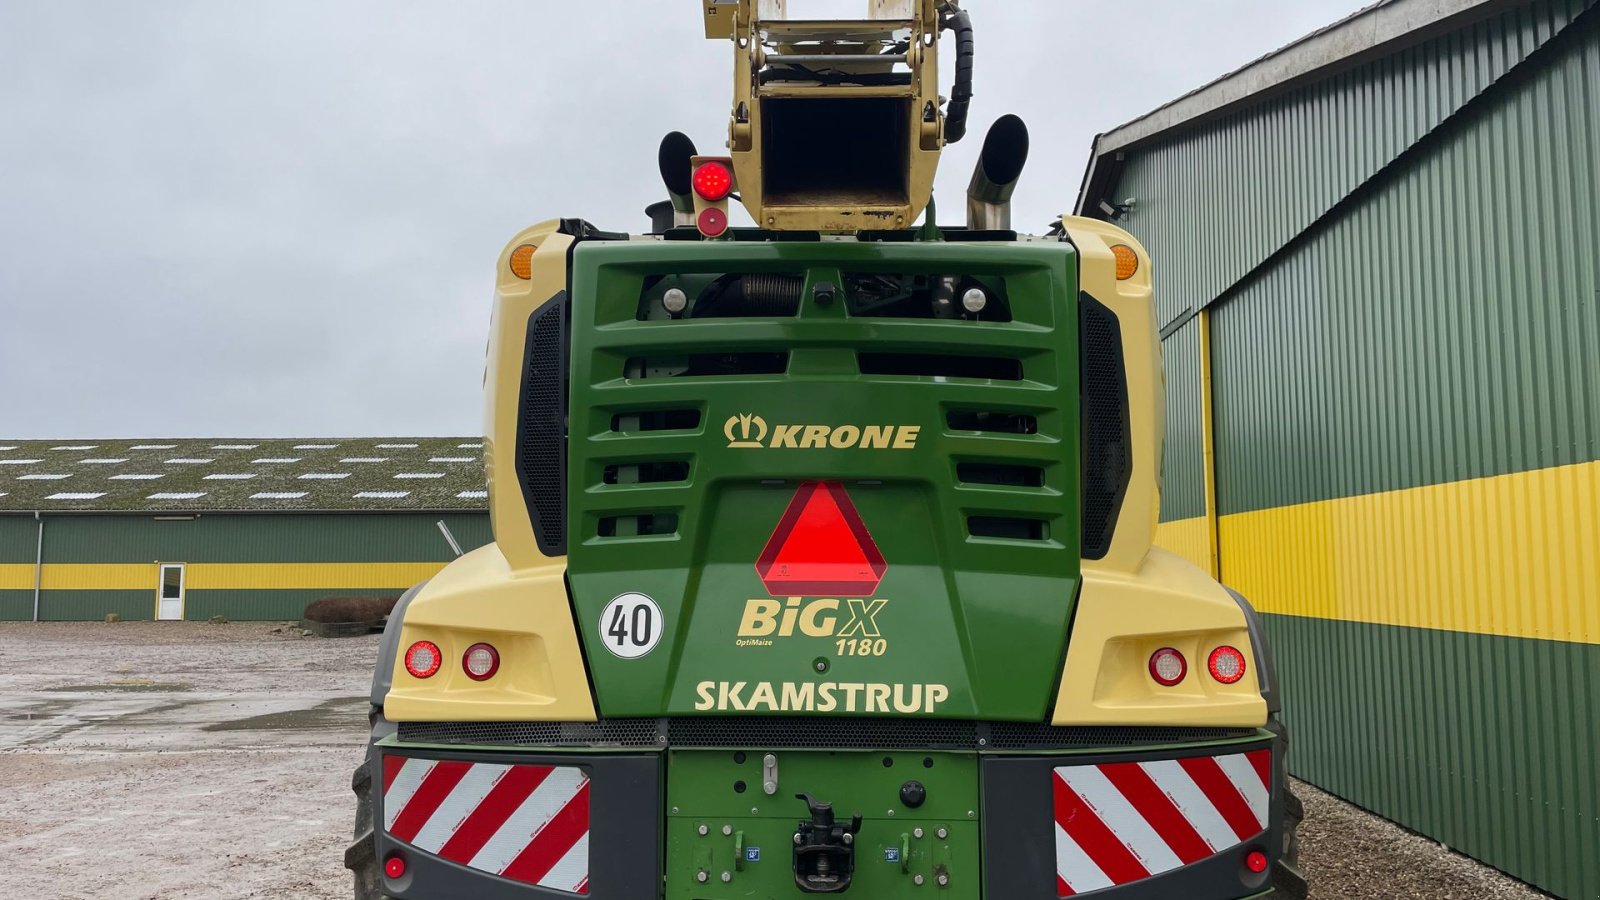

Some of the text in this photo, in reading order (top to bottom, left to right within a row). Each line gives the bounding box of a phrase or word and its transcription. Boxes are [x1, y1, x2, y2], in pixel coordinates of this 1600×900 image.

[769, 424, 921, 449] KRONE
[608, 604, 653, 647] 40
[735, 638, 773, 648] OptiMaize
[835, 638, 888, 657] 1180
[694, 680, 949, 714] SKAMSTRUP
